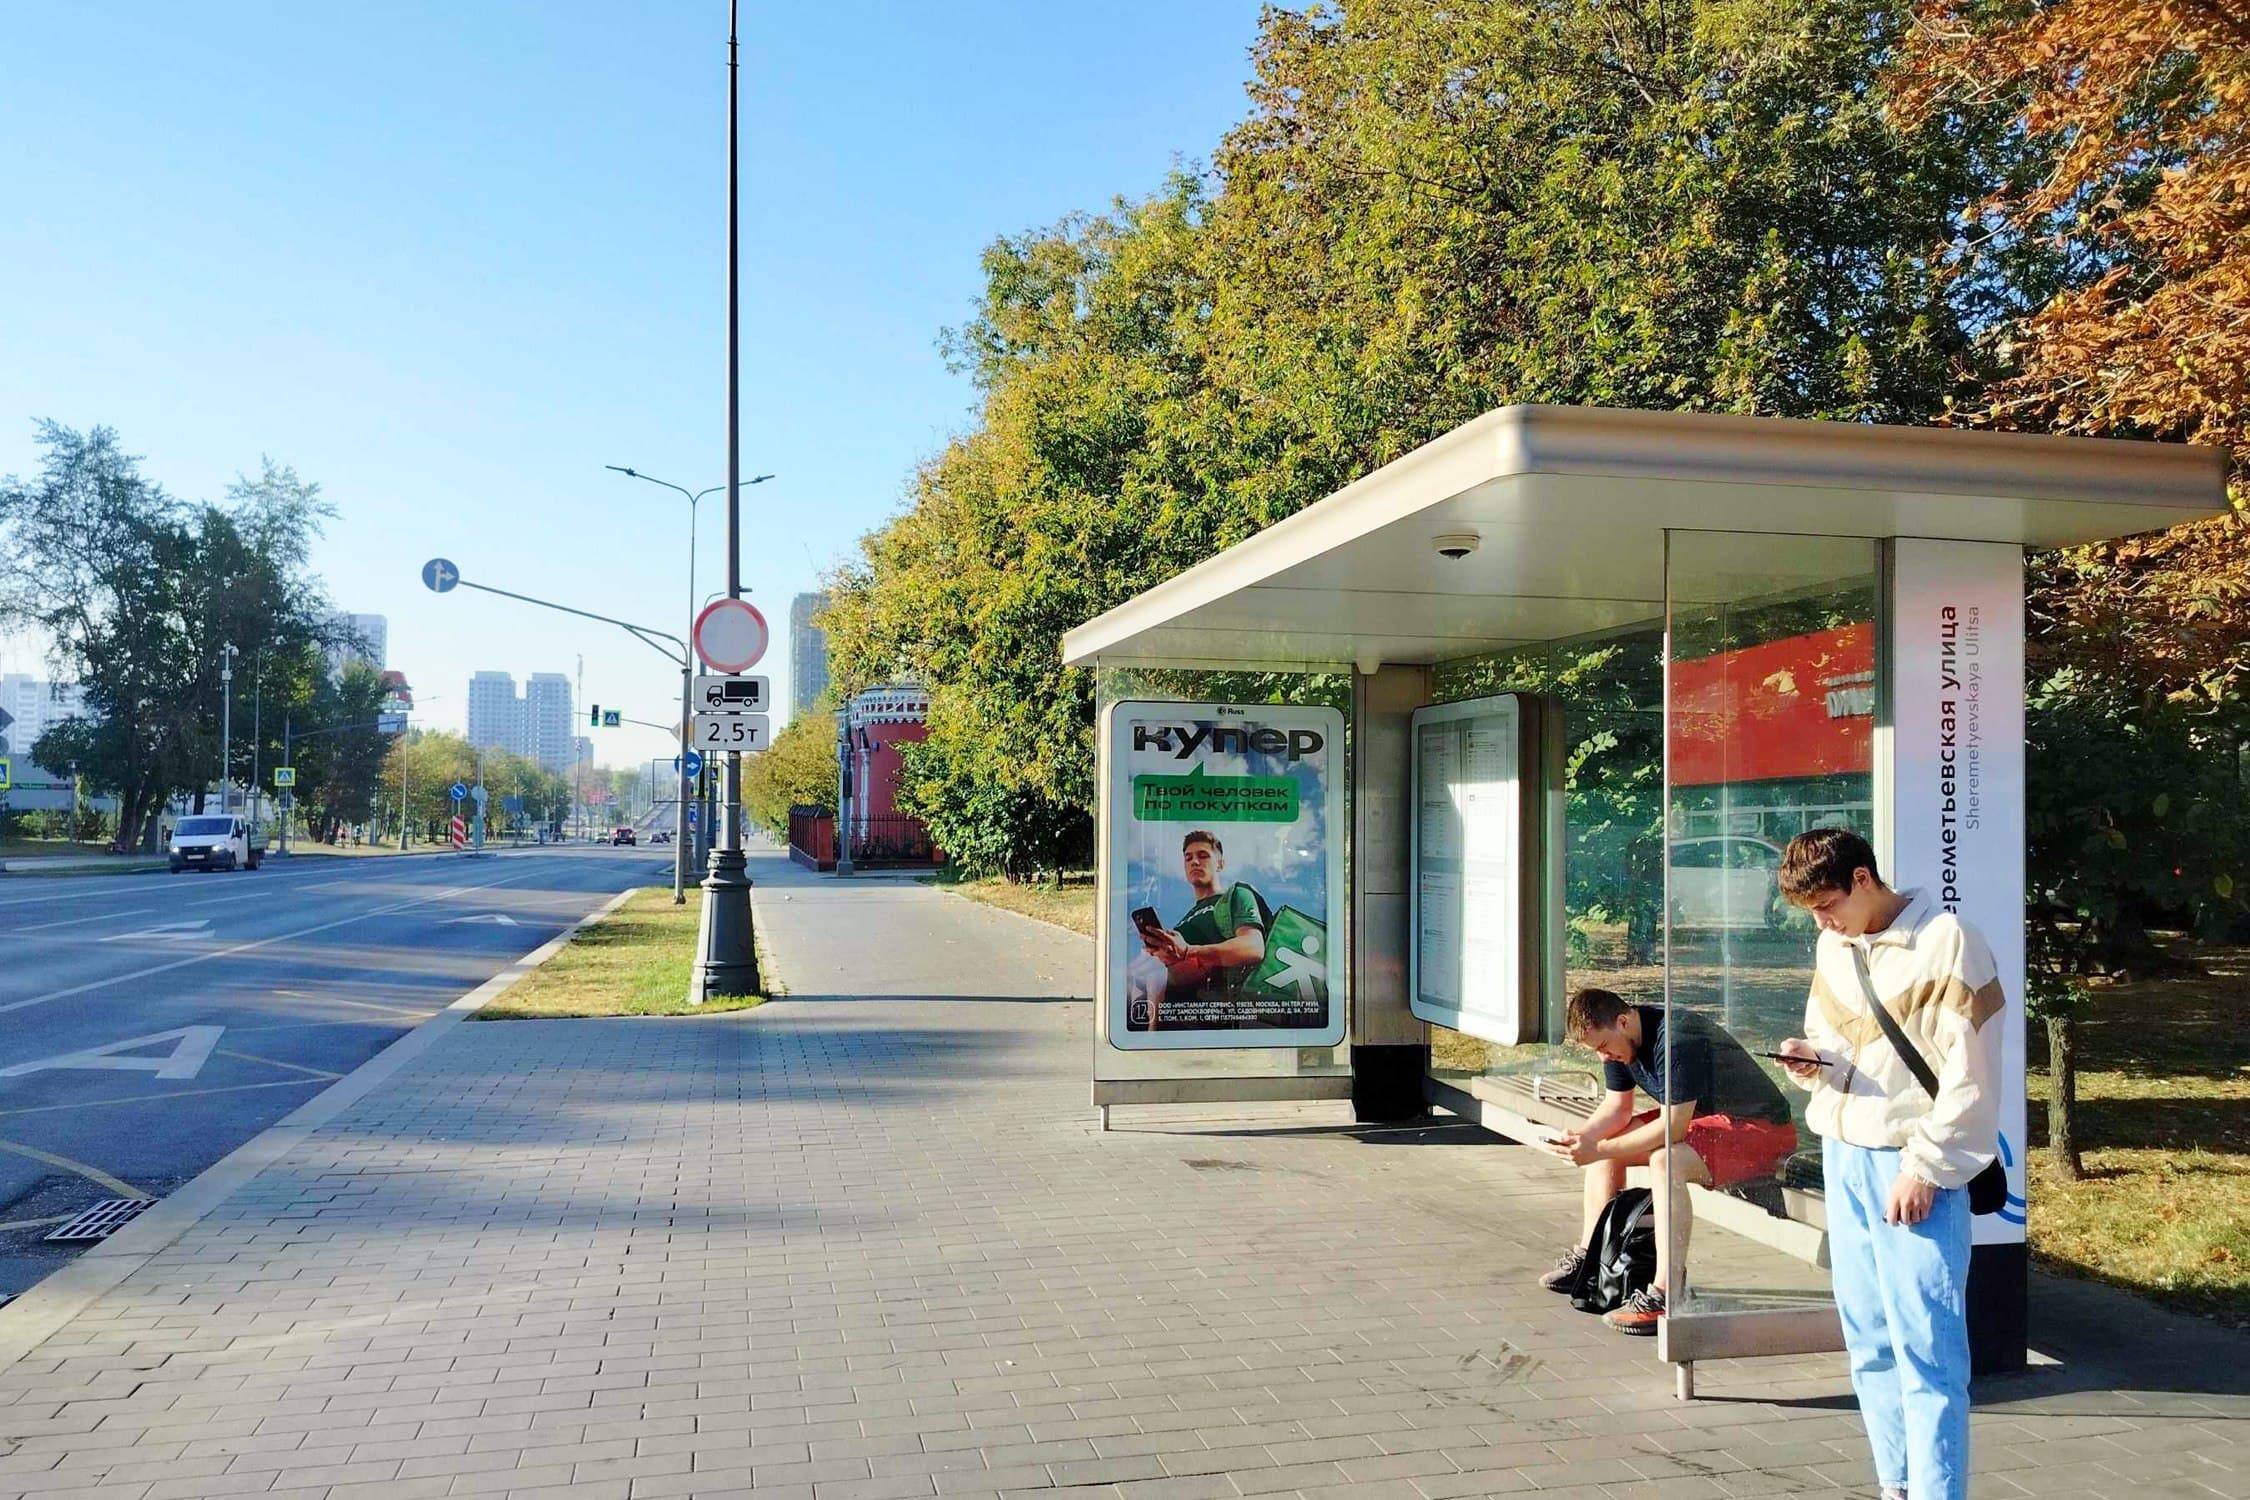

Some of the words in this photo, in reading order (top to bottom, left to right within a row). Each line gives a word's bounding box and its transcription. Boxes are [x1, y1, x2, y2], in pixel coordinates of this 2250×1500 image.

[1941, 606, 1961, 689] улица
[1965, 606, 1979, 655] Ulitsa
[1133, 725, 1325, 761] купер
[1965, 663, 1983, 830] Sheremetyevskaya
[1142, 784, 1195, 797] Твой
[1201, 787, 1289, 798] человек
[1145, 800, 1172, 810] по
[1180, 800, 1288, 813] покупкам
